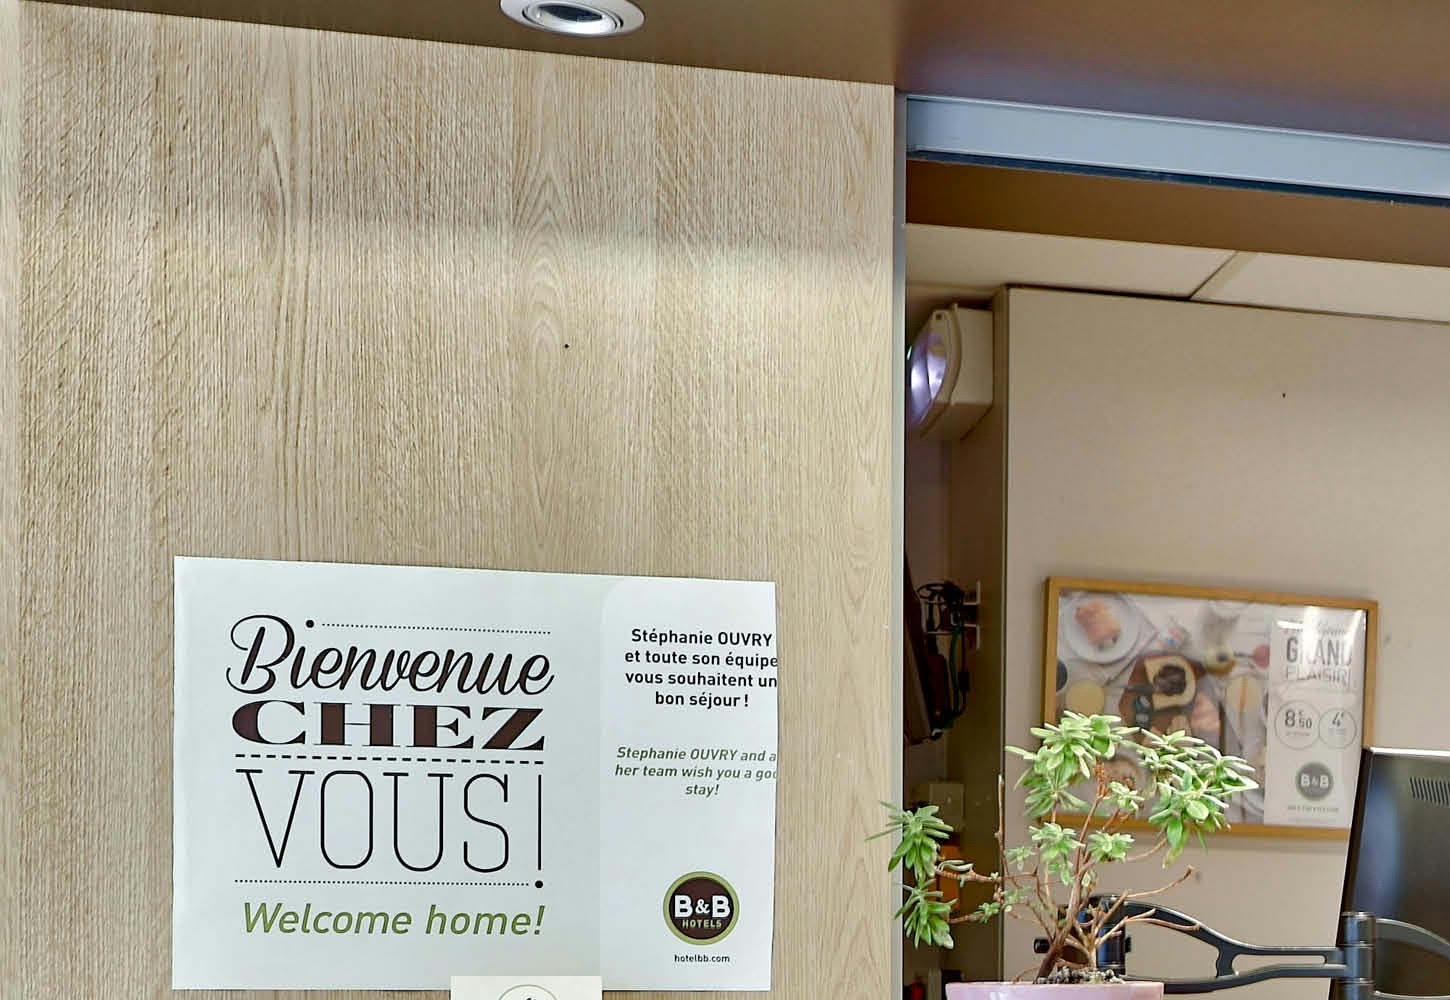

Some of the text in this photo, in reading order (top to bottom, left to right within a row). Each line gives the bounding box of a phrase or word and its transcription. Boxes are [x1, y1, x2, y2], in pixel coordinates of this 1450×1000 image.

[631, 628, 772, 646] Stéphanie OUVRY
[226, 614, 554, 694] Bienvenue
[625, 652, 778, 670] et toute son équipe
[625, 672, 777, 687] vous souhaitent un
[655, 692, 684, 705] bon
[689, 692, 740, 709] séjour
[231, 699, 546, 750] CHEZ
[617, 747, 686, 762] Stephanie
[690, 749, 738, 760] OUVRY
[741, 750, 765, 761] and
[615, 765, 639, 776] her
[643, 766, 677, 777] team
[681, 766, 713, 778] wish
[717, 769, 740, 780] you
[744, 770, 752, 778] a
[685, 784, 719, 797] stay!
[235, 768, 544, 888] VOUS!
[674, 895, 730, 917] B&B
[243, 902, 545, 936] Welcome home!
[683, 920, 722, 928] HOTELS
[674, 954, 730, 962] hotelbb.com
